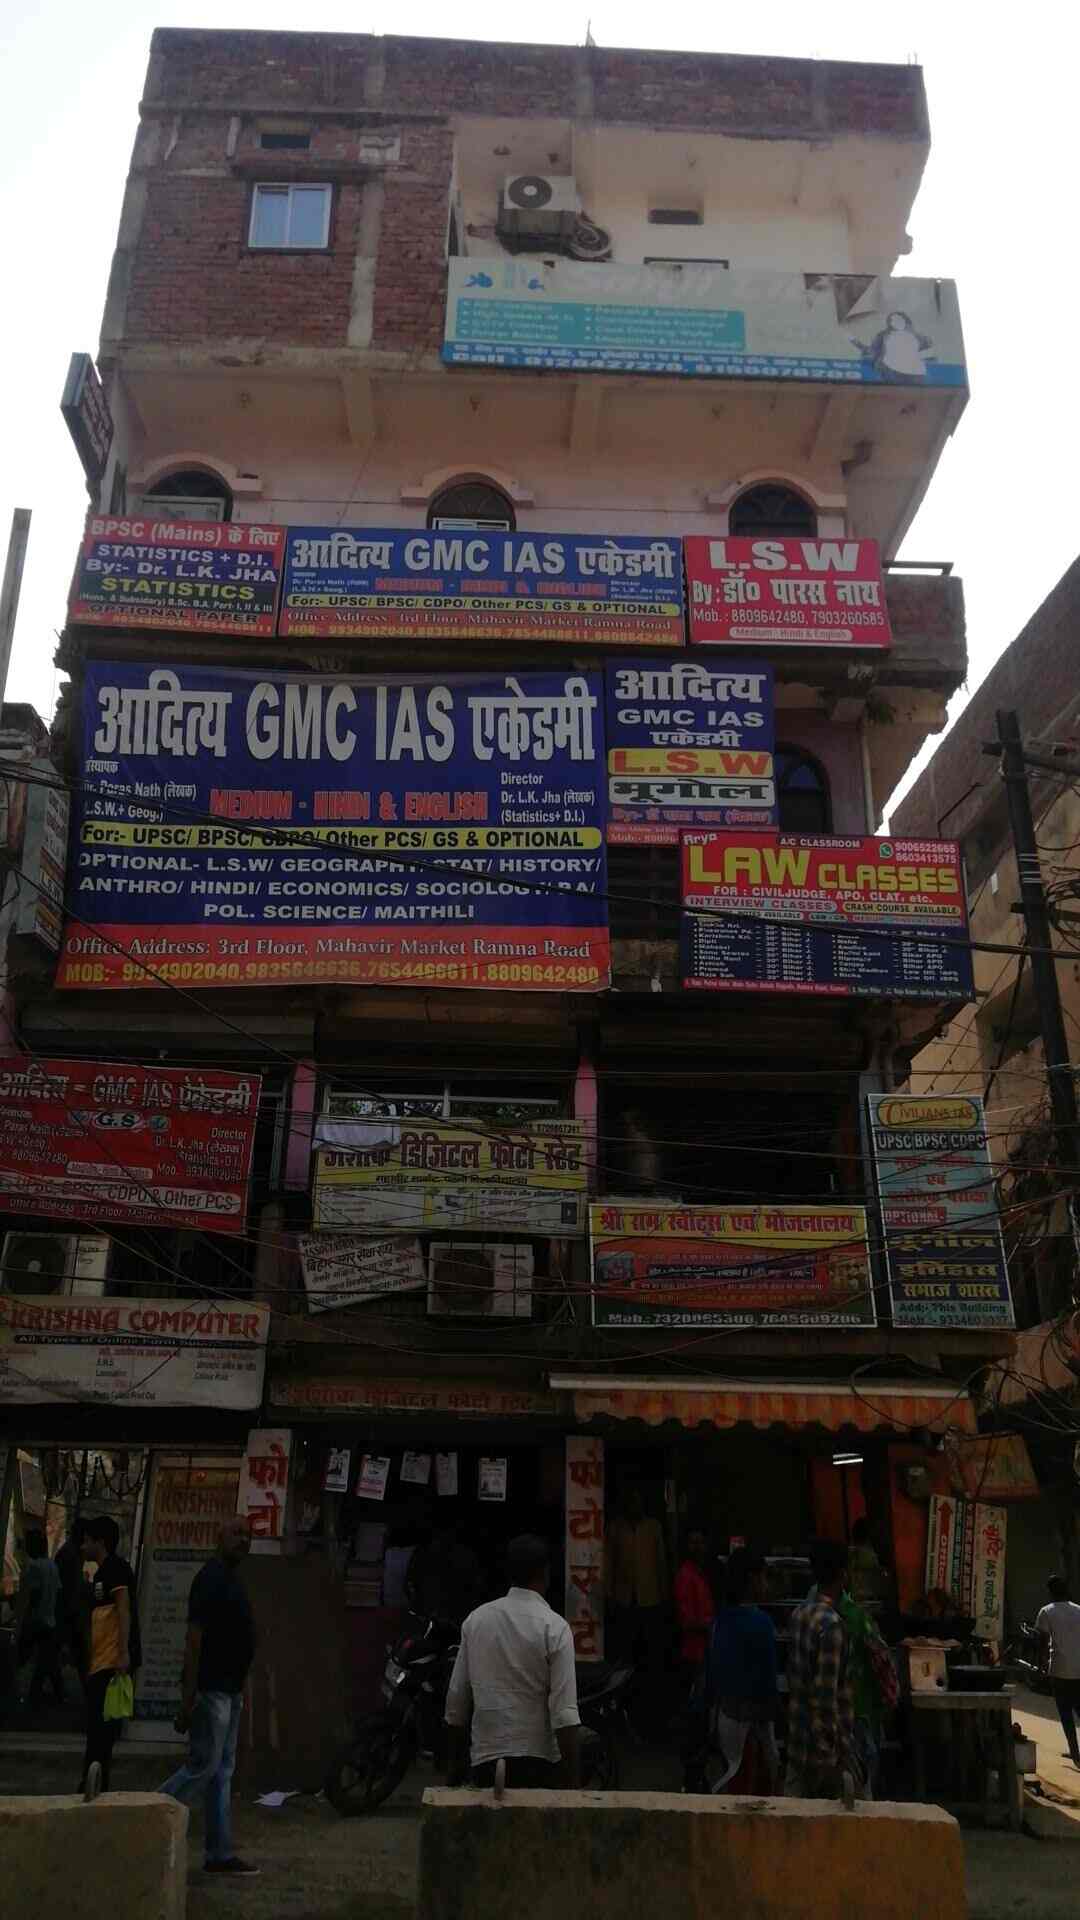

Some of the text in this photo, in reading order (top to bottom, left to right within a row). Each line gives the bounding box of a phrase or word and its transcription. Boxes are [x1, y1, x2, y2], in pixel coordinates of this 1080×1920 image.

[91, 519, 145, 538] BPSC
[151, 523, 222, 547] (Mains)
[228, 526, 244, 544] के
[98, 544, 213, 563] STATISTICS
[292, 532, 677, 578] आदित्य GMC IAS एकेडमी
[709, 540, 860, 572] L.S.W
[137, 562, 167, 575] Dr.
[176, 564, 221, 579] L.K.
[229, 568, 277, 582] JHA
[102, 577, 255, 600] STATISTICS
[196, 609, 258, 624] PAPER
[472, 599, 512, 610] Other
[593, 603, 667, 615] OPTIONAL
[615, 663, 768, 702] आदित्य
[94, 669, 598, 762] आदित्य GMC IAS एकेडमी
[617, 709, 765, 727] GMC IAS
[649, 728, 743, 747] एकेडमी
[501, 772, 544, 785] Director
[135, 782, 162, 798] Nath
[501, 791, 516, 804] Dr.
[541, 791, 561, 804] Jha
[209, 788, 489, 821] MEDIUM HINDI & ENGLISH
[326, 830, 379, 848] Other
[433, 831, 459, 848] GS
[466, 831, 479, 847] &
[486, 831, 584, 847] OPTIONAL
[800, 838, 861, 849] CLASSROOM
[689, 845, 959, 893] LAW CLASSES
[79, 878, 184, 895] ANTHRO/
[190, 880, 263, 896] HINDI/
[268, 882, 409, 897] ECONOMICS/
[203, 904, 475, 920] POL. SCIENCE/ MAITHILI
[772, 900, 833, 911] CLASSES
[845, 903, 874, 912] CRASH
[877, 904, 911, 914] COURSE
[66, 937, 123, 955] Office
[218, 939, 250, 955] 3rd
[316, 939, 394, 955] Mahavir
[400, 939, 466, 955] Market
[473, 939, 538, 957] Ramna
[544, 941, 591, 958] Road
[164, 1190, 201, 1208] Other
[205, 1195, 235, 1210] PCS
[128, 1310, 262, 1338] COMPUTER
